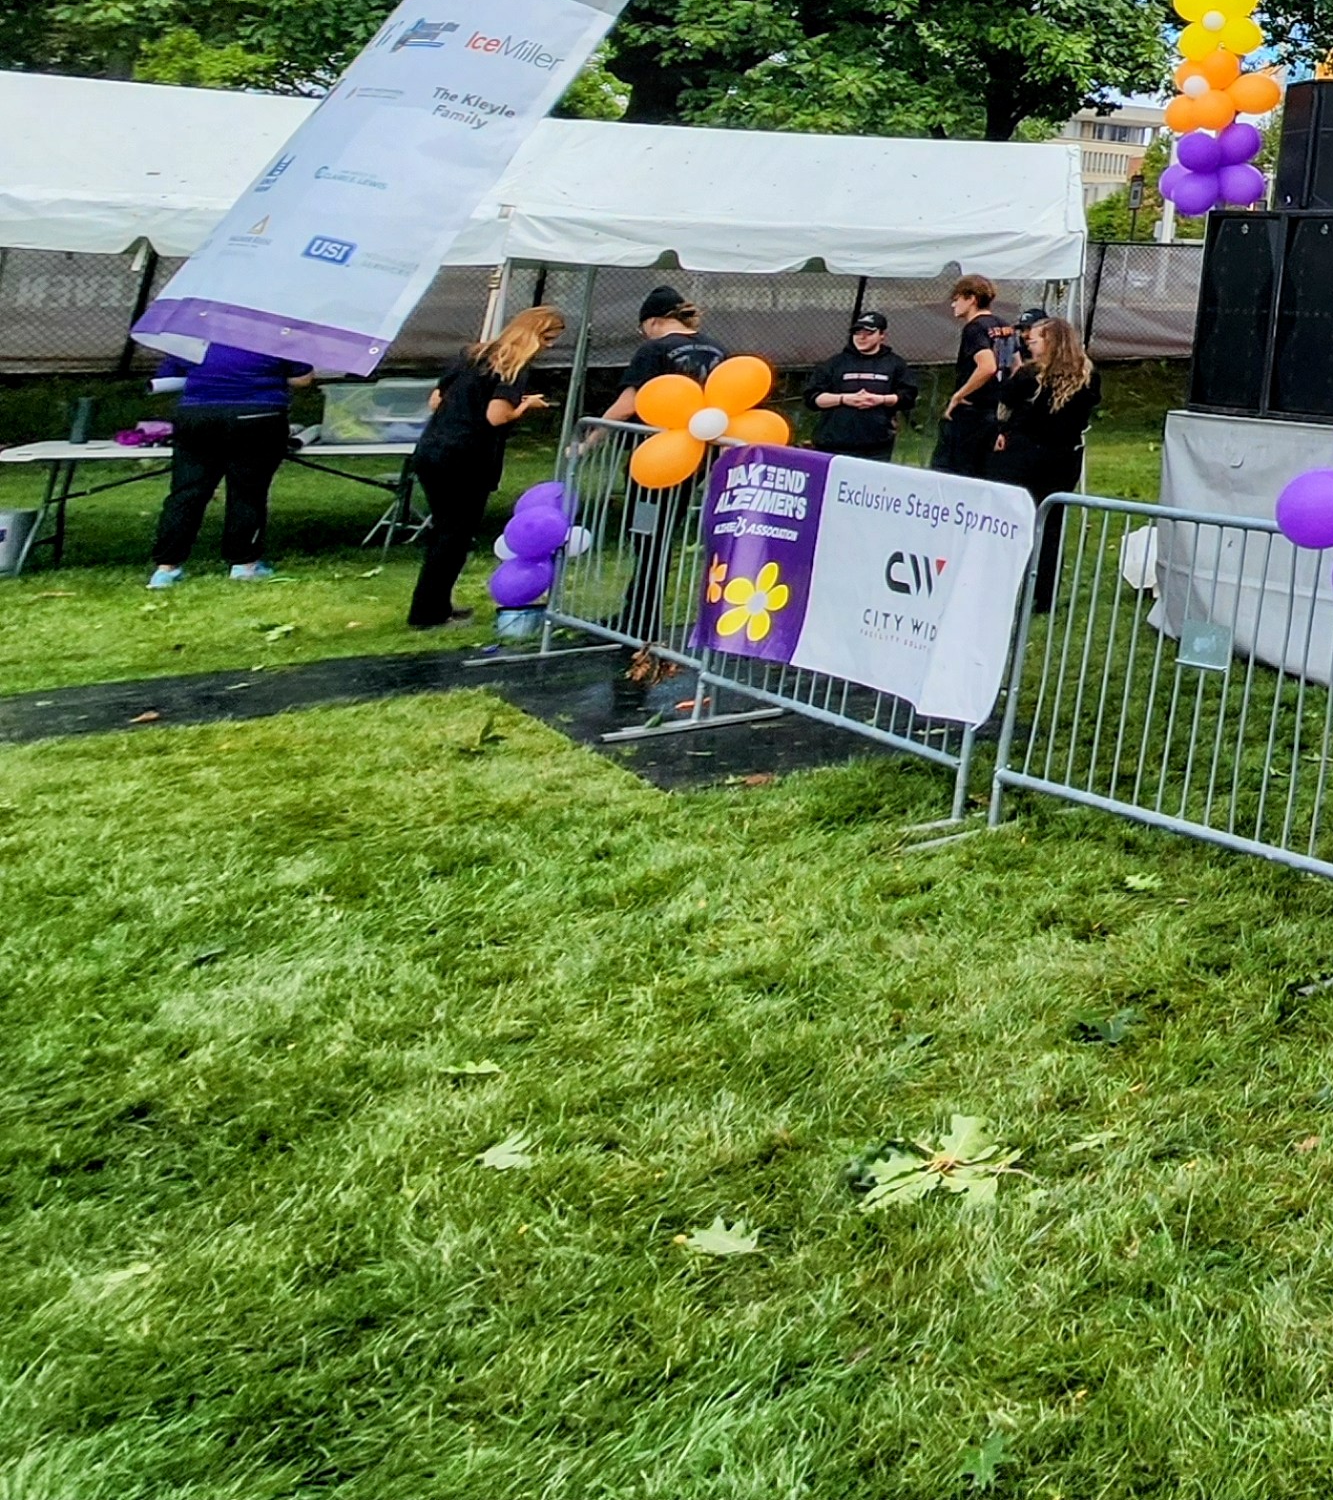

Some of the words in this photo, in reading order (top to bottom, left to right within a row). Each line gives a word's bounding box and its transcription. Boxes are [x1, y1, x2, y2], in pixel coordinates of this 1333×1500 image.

[432, 86, 456, 102] The
[432, 104, 489, 130] Family
[309, 239, 351, 262] USI
[837, 481, 901, 513] Exclusive
[905, 493, 950, 528] Stage
[862, 608, 904, 631] CITY
[911, 617, 938, 642] WID
